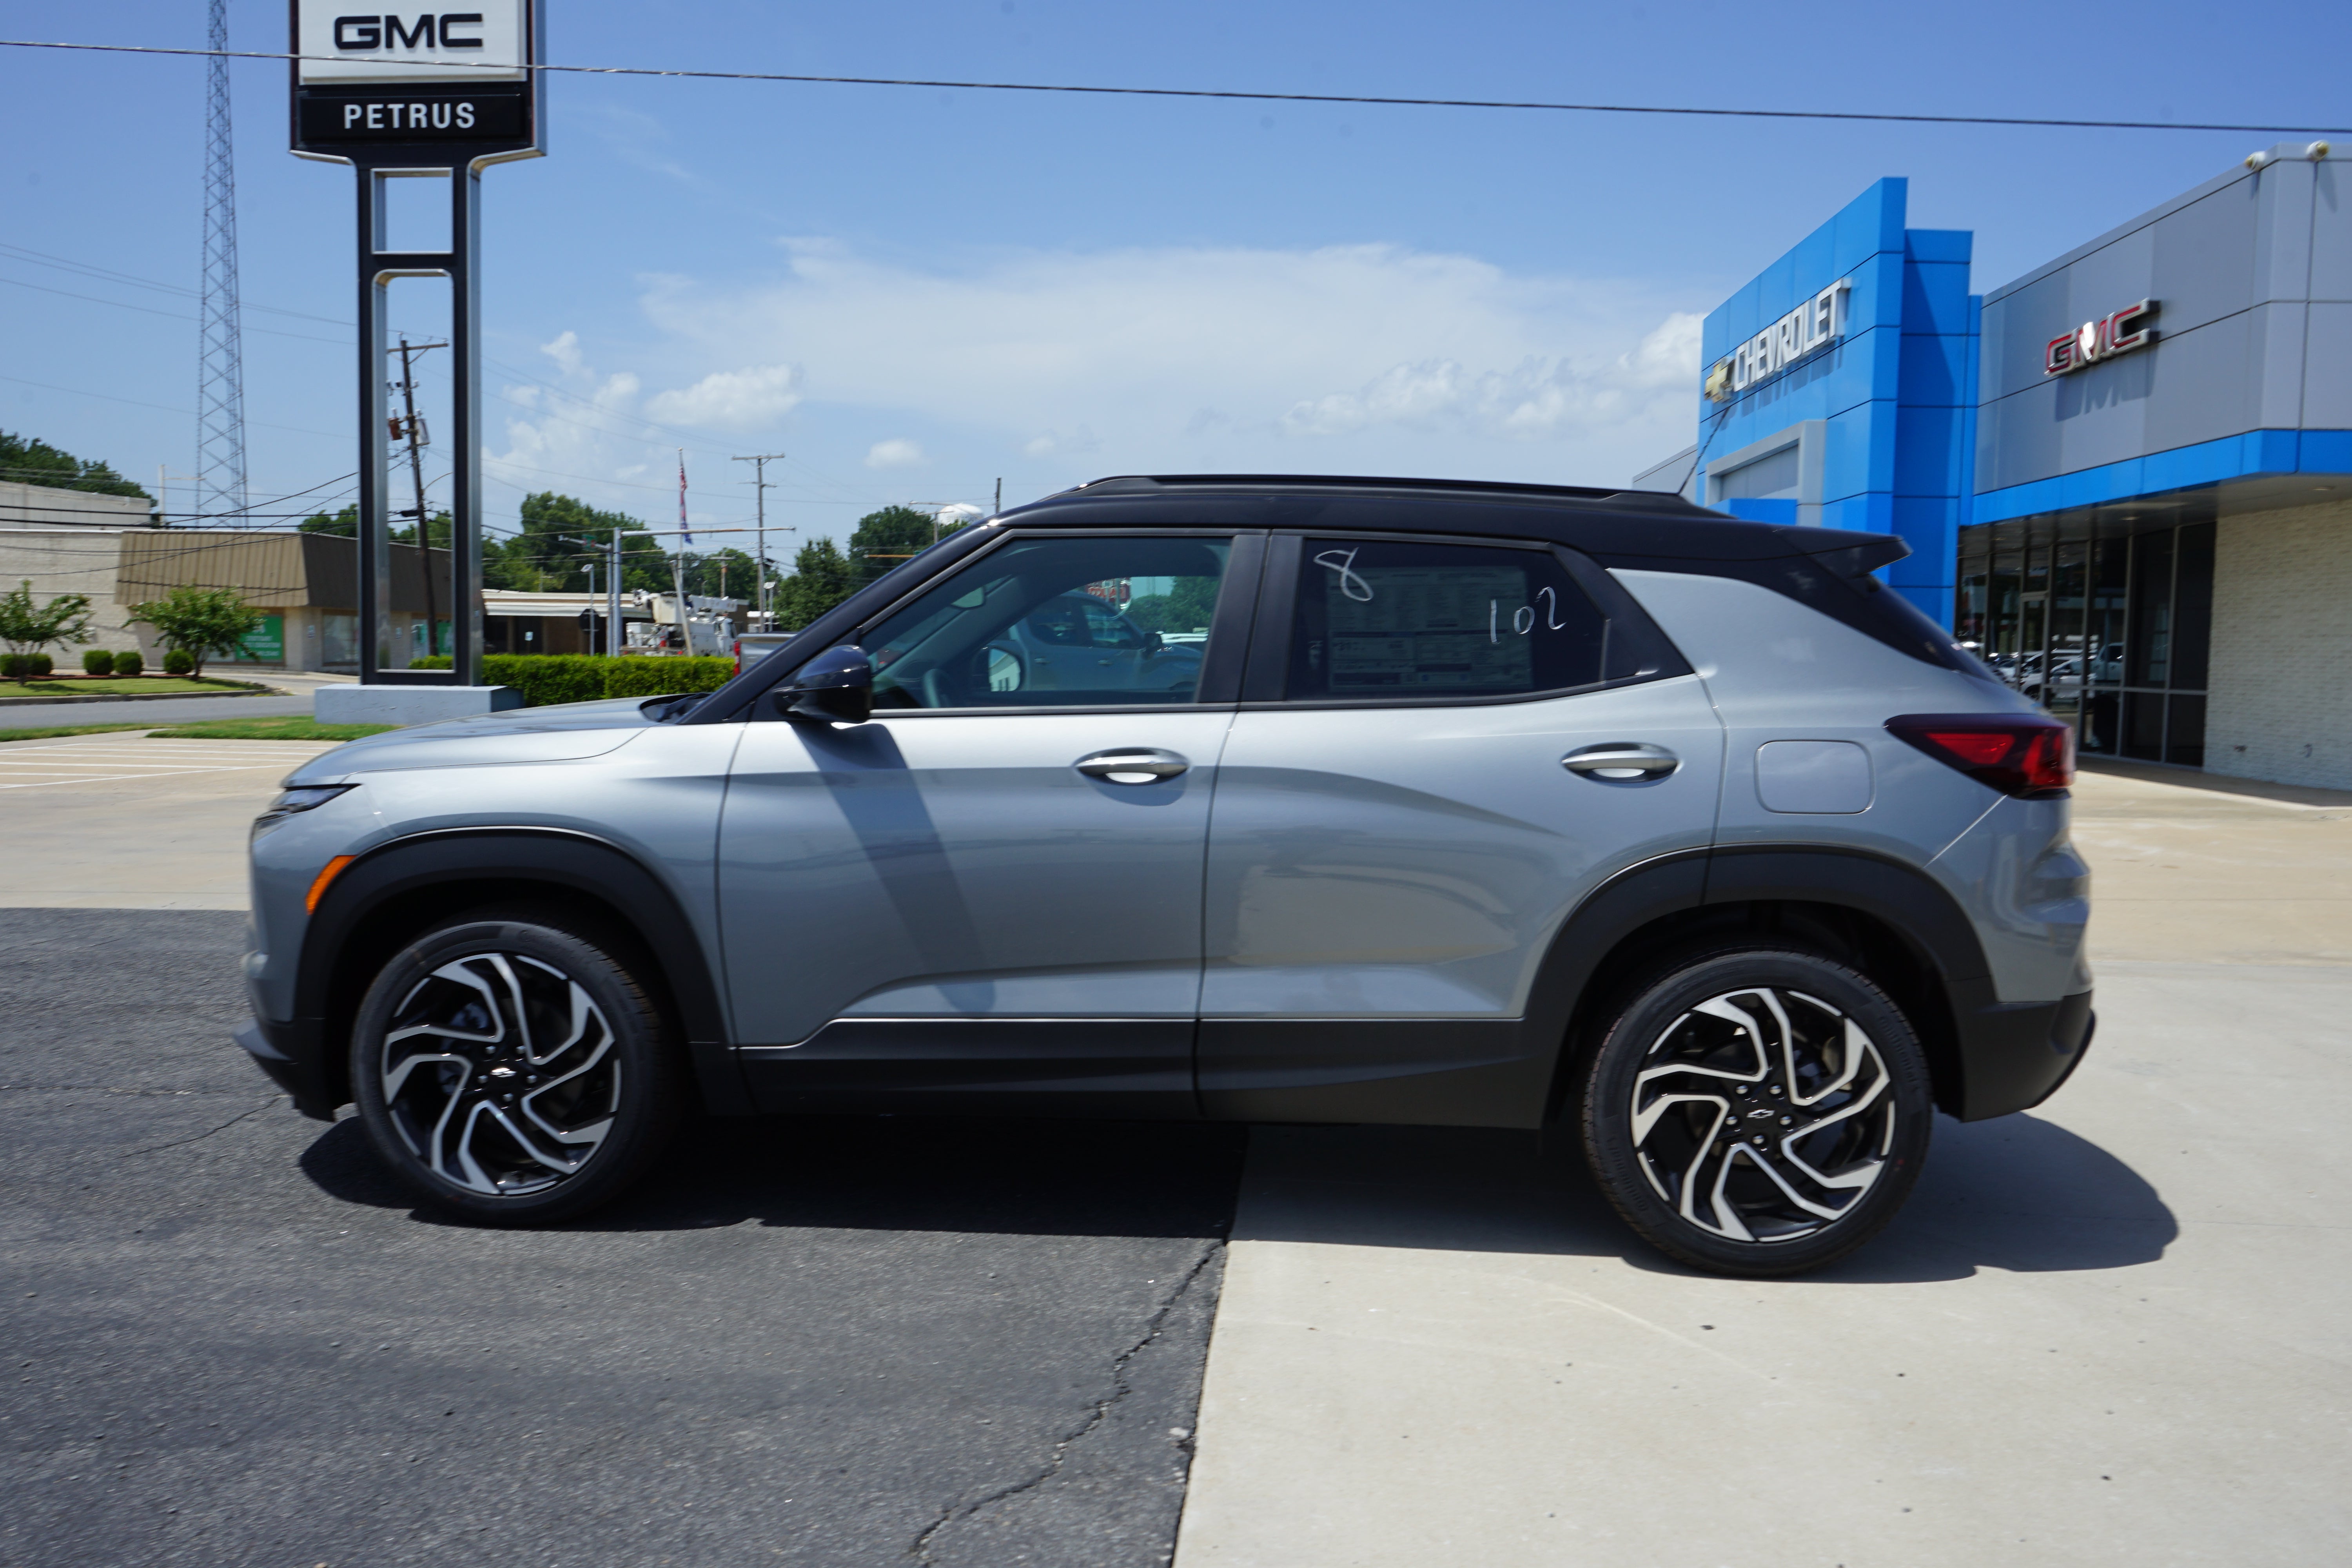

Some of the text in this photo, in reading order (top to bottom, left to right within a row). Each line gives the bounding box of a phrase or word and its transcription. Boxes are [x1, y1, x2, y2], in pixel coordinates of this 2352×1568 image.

[334, 13, 483, 49] GMC
[343, 102, 475, 129] PETRUS
[1733, 277, 1853, 392] CHEVROLET
[2044, 298, 2161, 377] GMC
